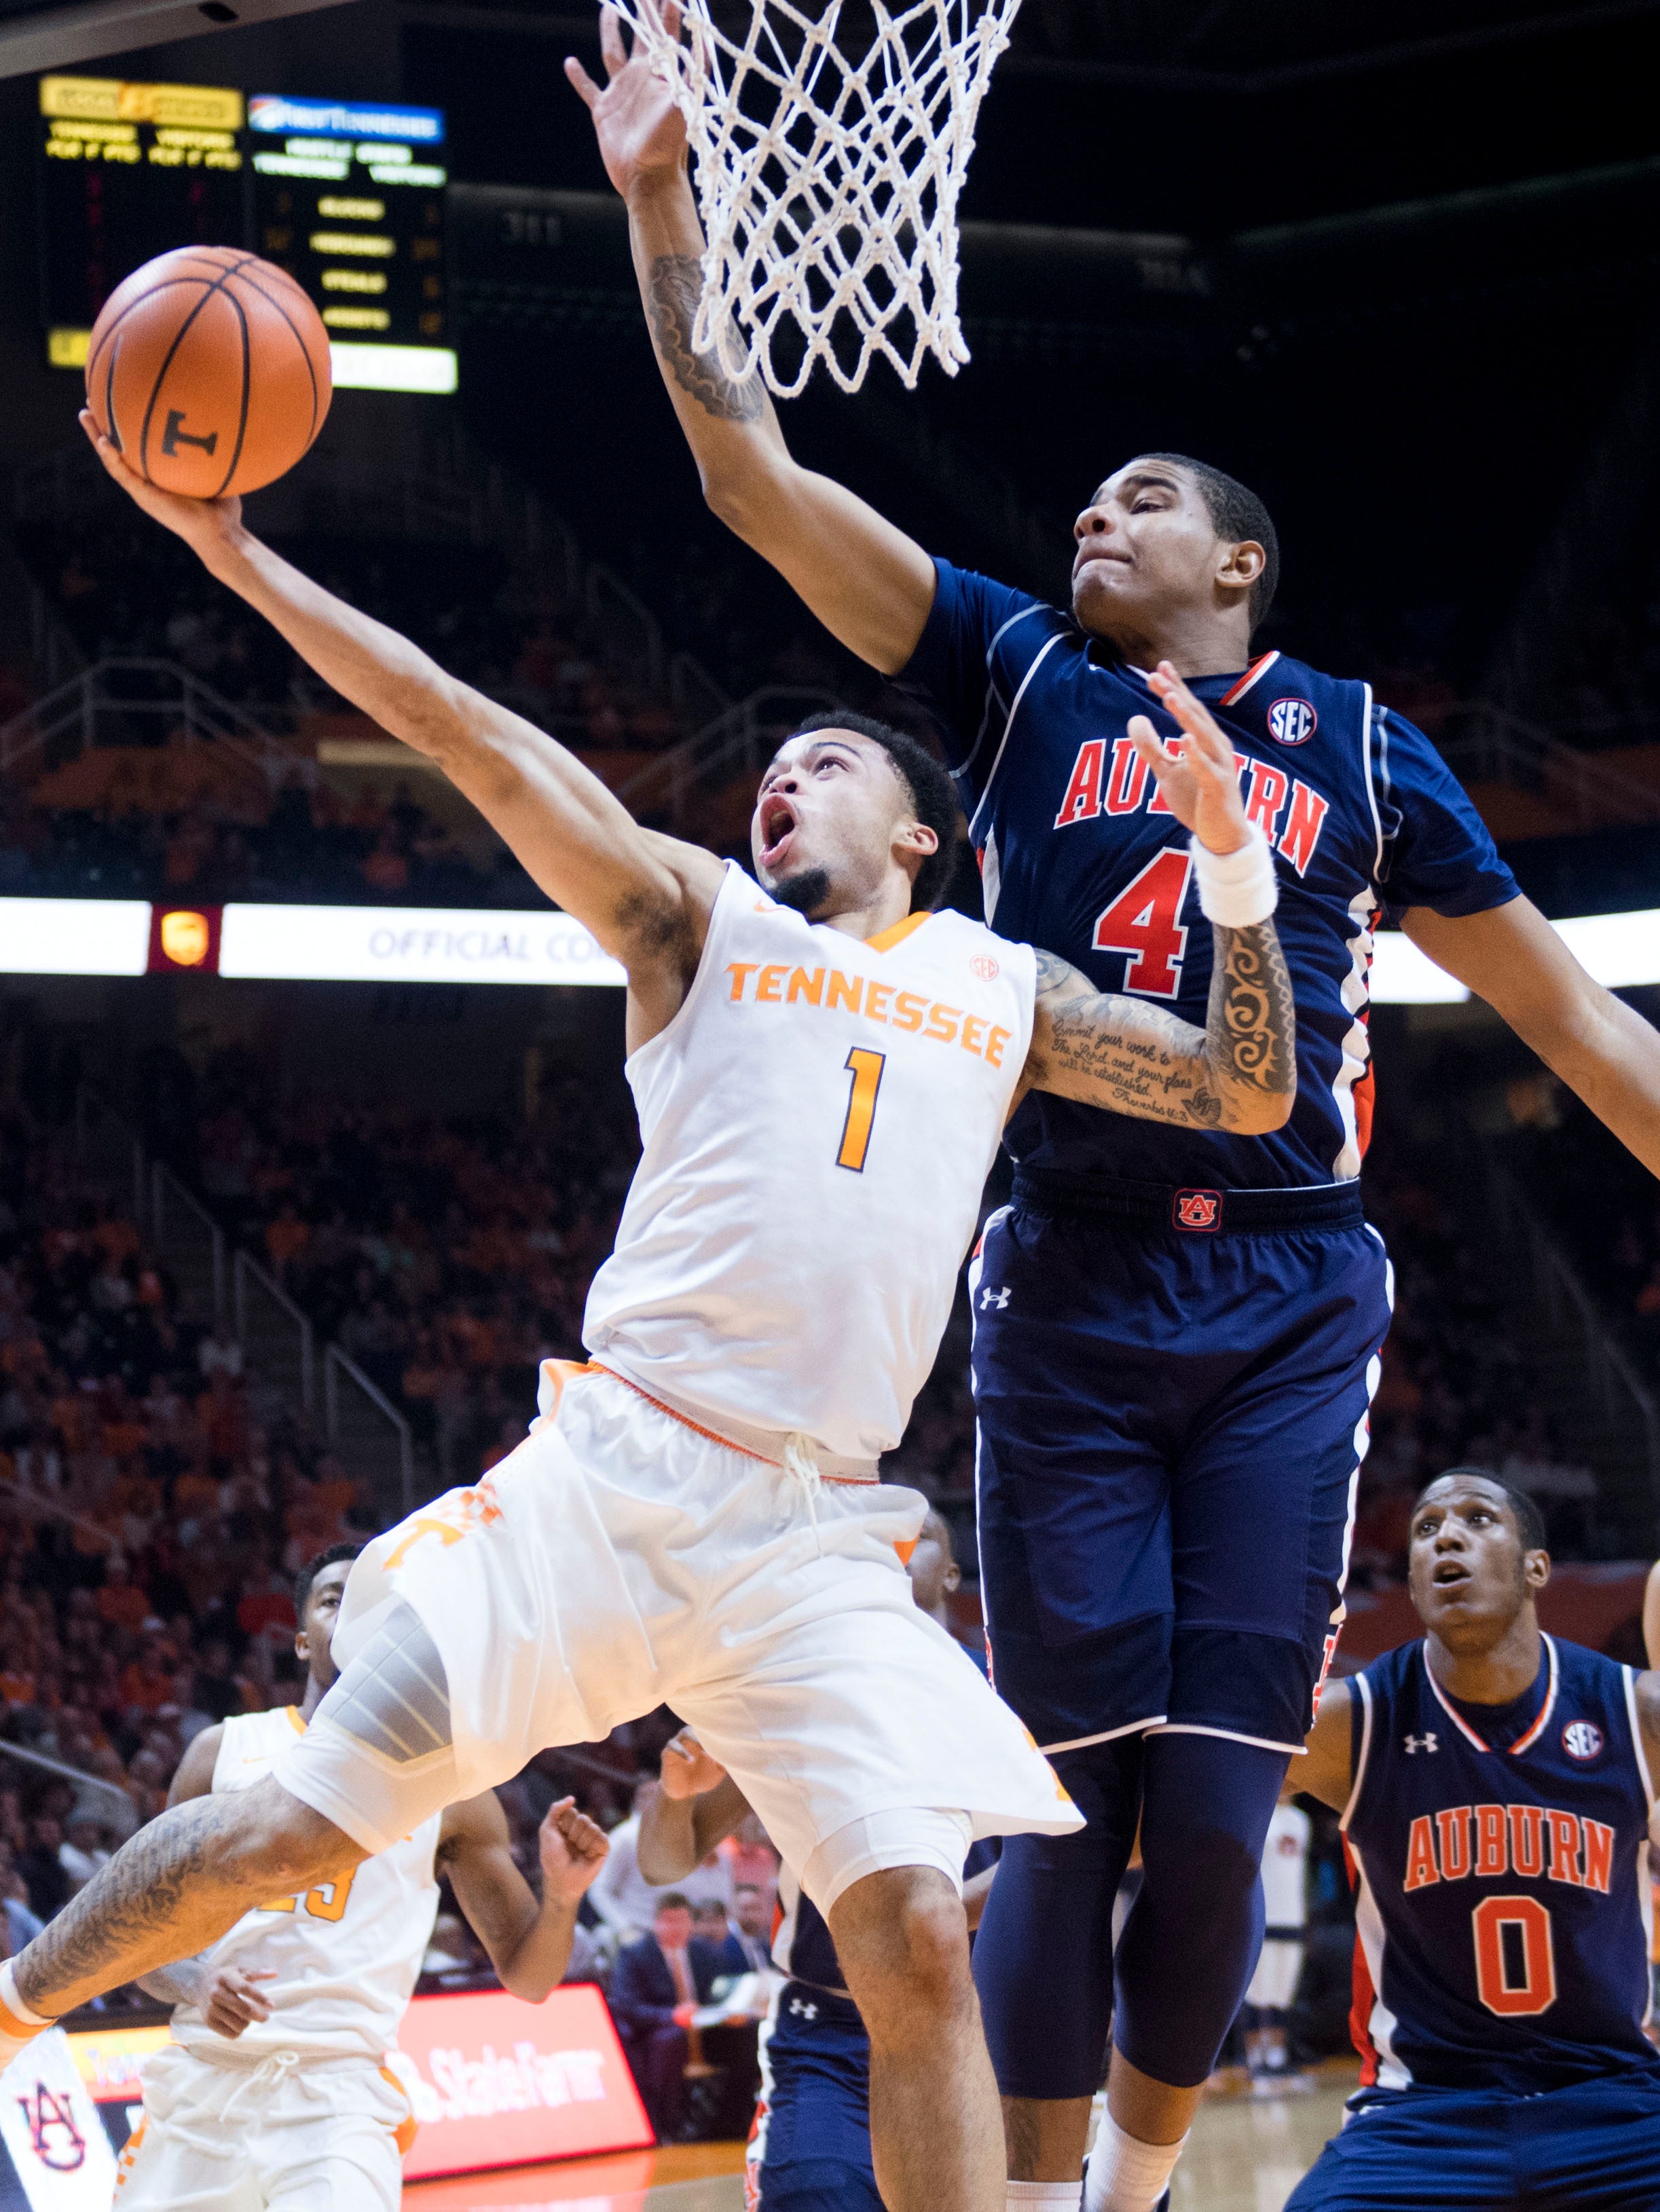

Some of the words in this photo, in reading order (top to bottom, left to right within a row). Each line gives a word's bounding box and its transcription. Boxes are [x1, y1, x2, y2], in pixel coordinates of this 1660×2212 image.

[162, 409, 219, 457] T
[1271, 700, 1312, 743] SEC
[1053, 737, 1330, 878] AURN
[367, 927, 532, 964] OFFICIAL
[547, 931, 608, 965] CO
[1092, 846, 1194, 1000] 4
[725, 962, 1012, 1070] TENNESSEE
[1094, 1032, 1123, 1049] your
[1126, 1041, 1156, 1062] work
[1111, 1059, 1135, 1073] and
[835, 1045, 886, 1173] 1
[1565, 1721, 1602, 1759] SEC
[1403, 1803, 1615, 1894] AUBURN
[1471, 1895, 1557, 2017] 0
